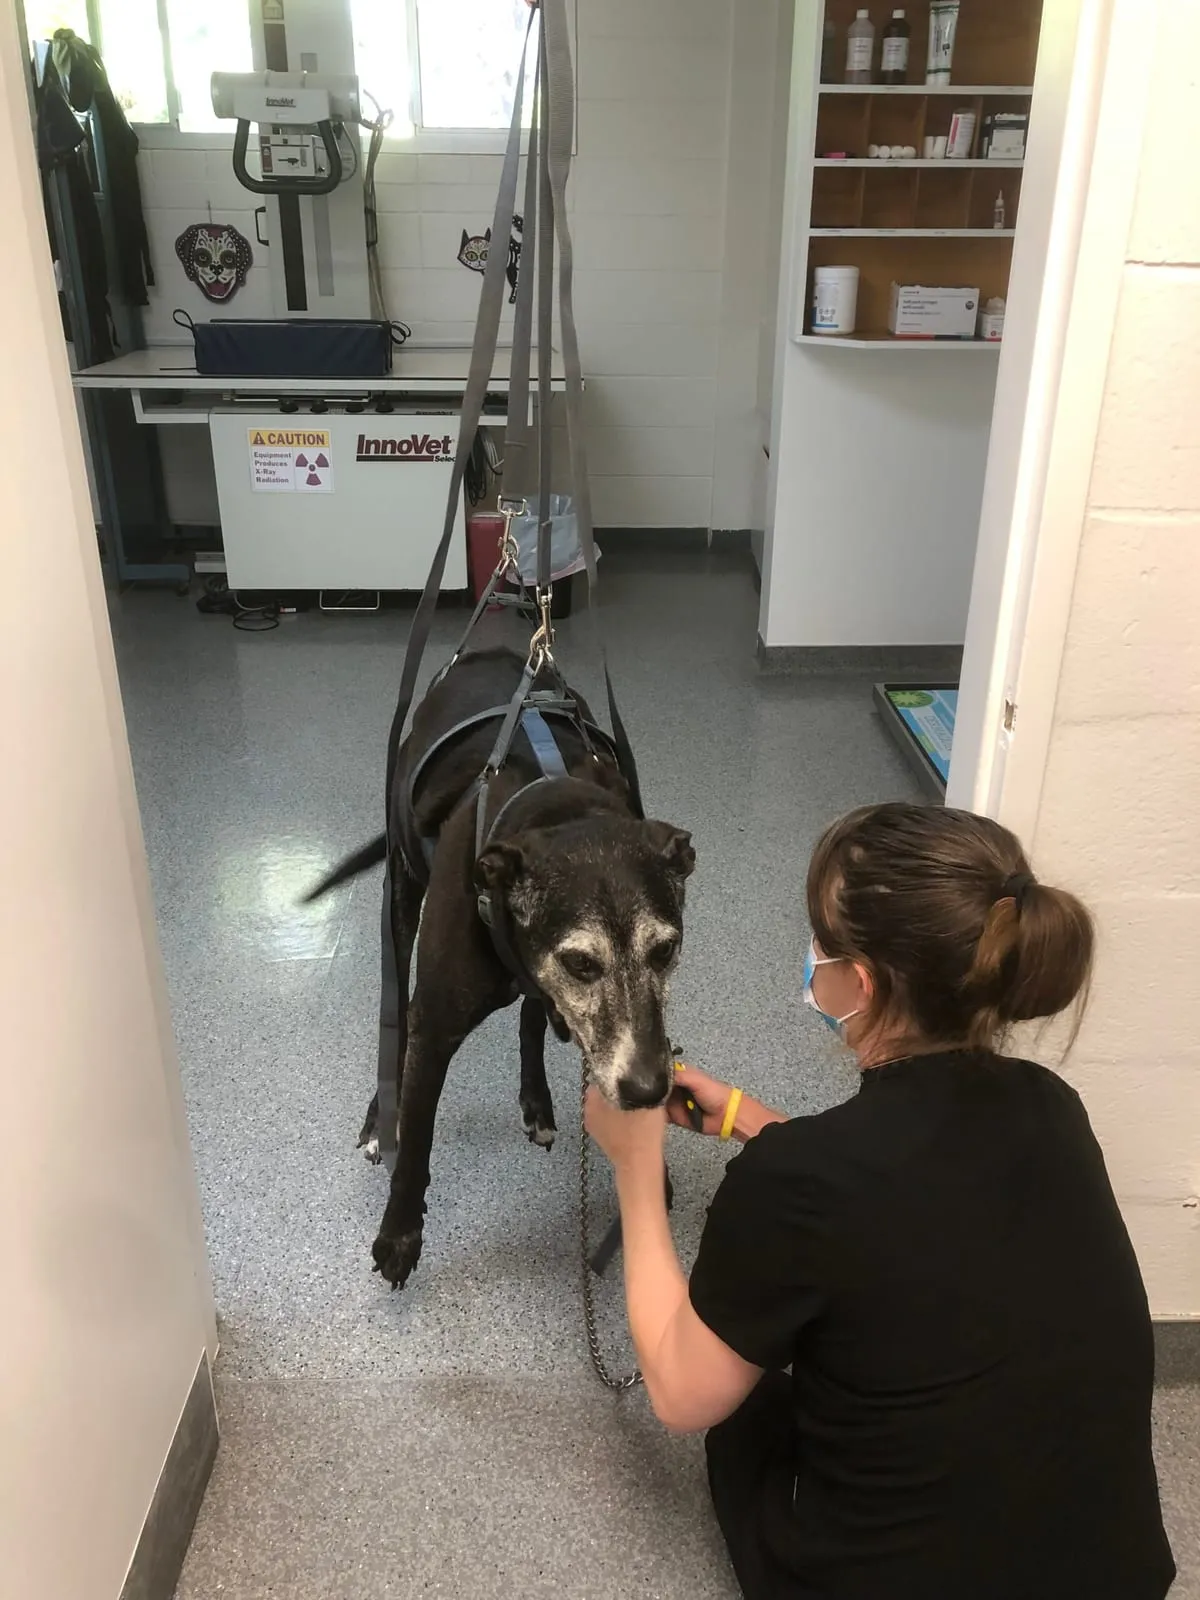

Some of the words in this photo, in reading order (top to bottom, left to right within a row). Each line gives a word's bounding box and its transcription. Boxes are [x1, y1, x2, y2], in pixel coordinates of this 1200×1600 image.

[267, 432, 325, 446] CAUTION
[357, 434, 452, 455] InnoVet
[254, 451, 292, 459] Equipment
[434, 455, 456, 463] Selec
